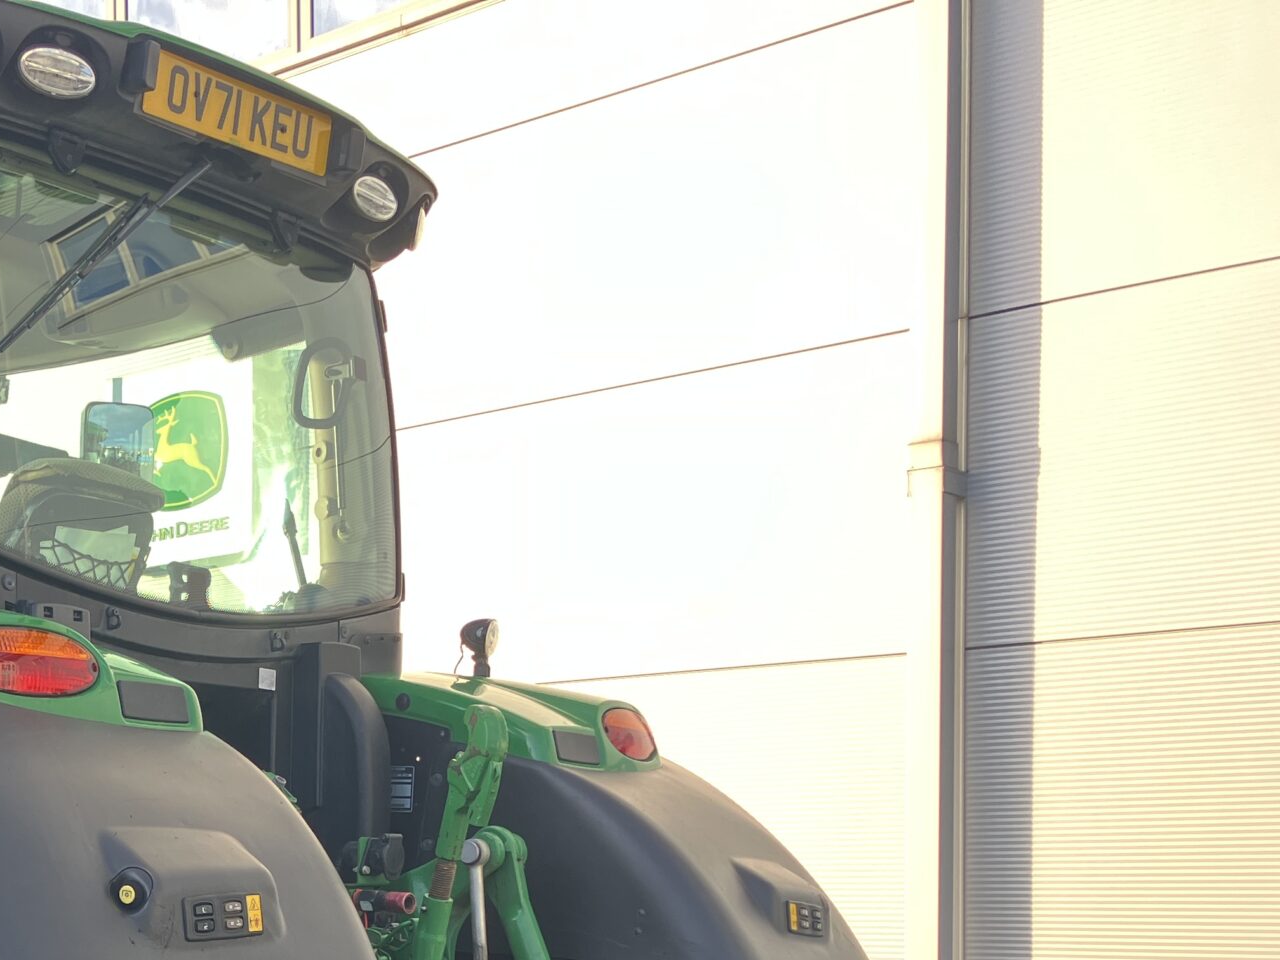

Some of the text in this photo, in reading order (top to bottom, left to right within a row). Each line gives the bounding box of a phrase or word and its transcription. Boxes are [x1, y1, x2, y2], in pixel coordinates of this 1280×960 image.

[167, 65, 314, 159] OV71 KEU
[176, 516, 230, 538] DEERE
